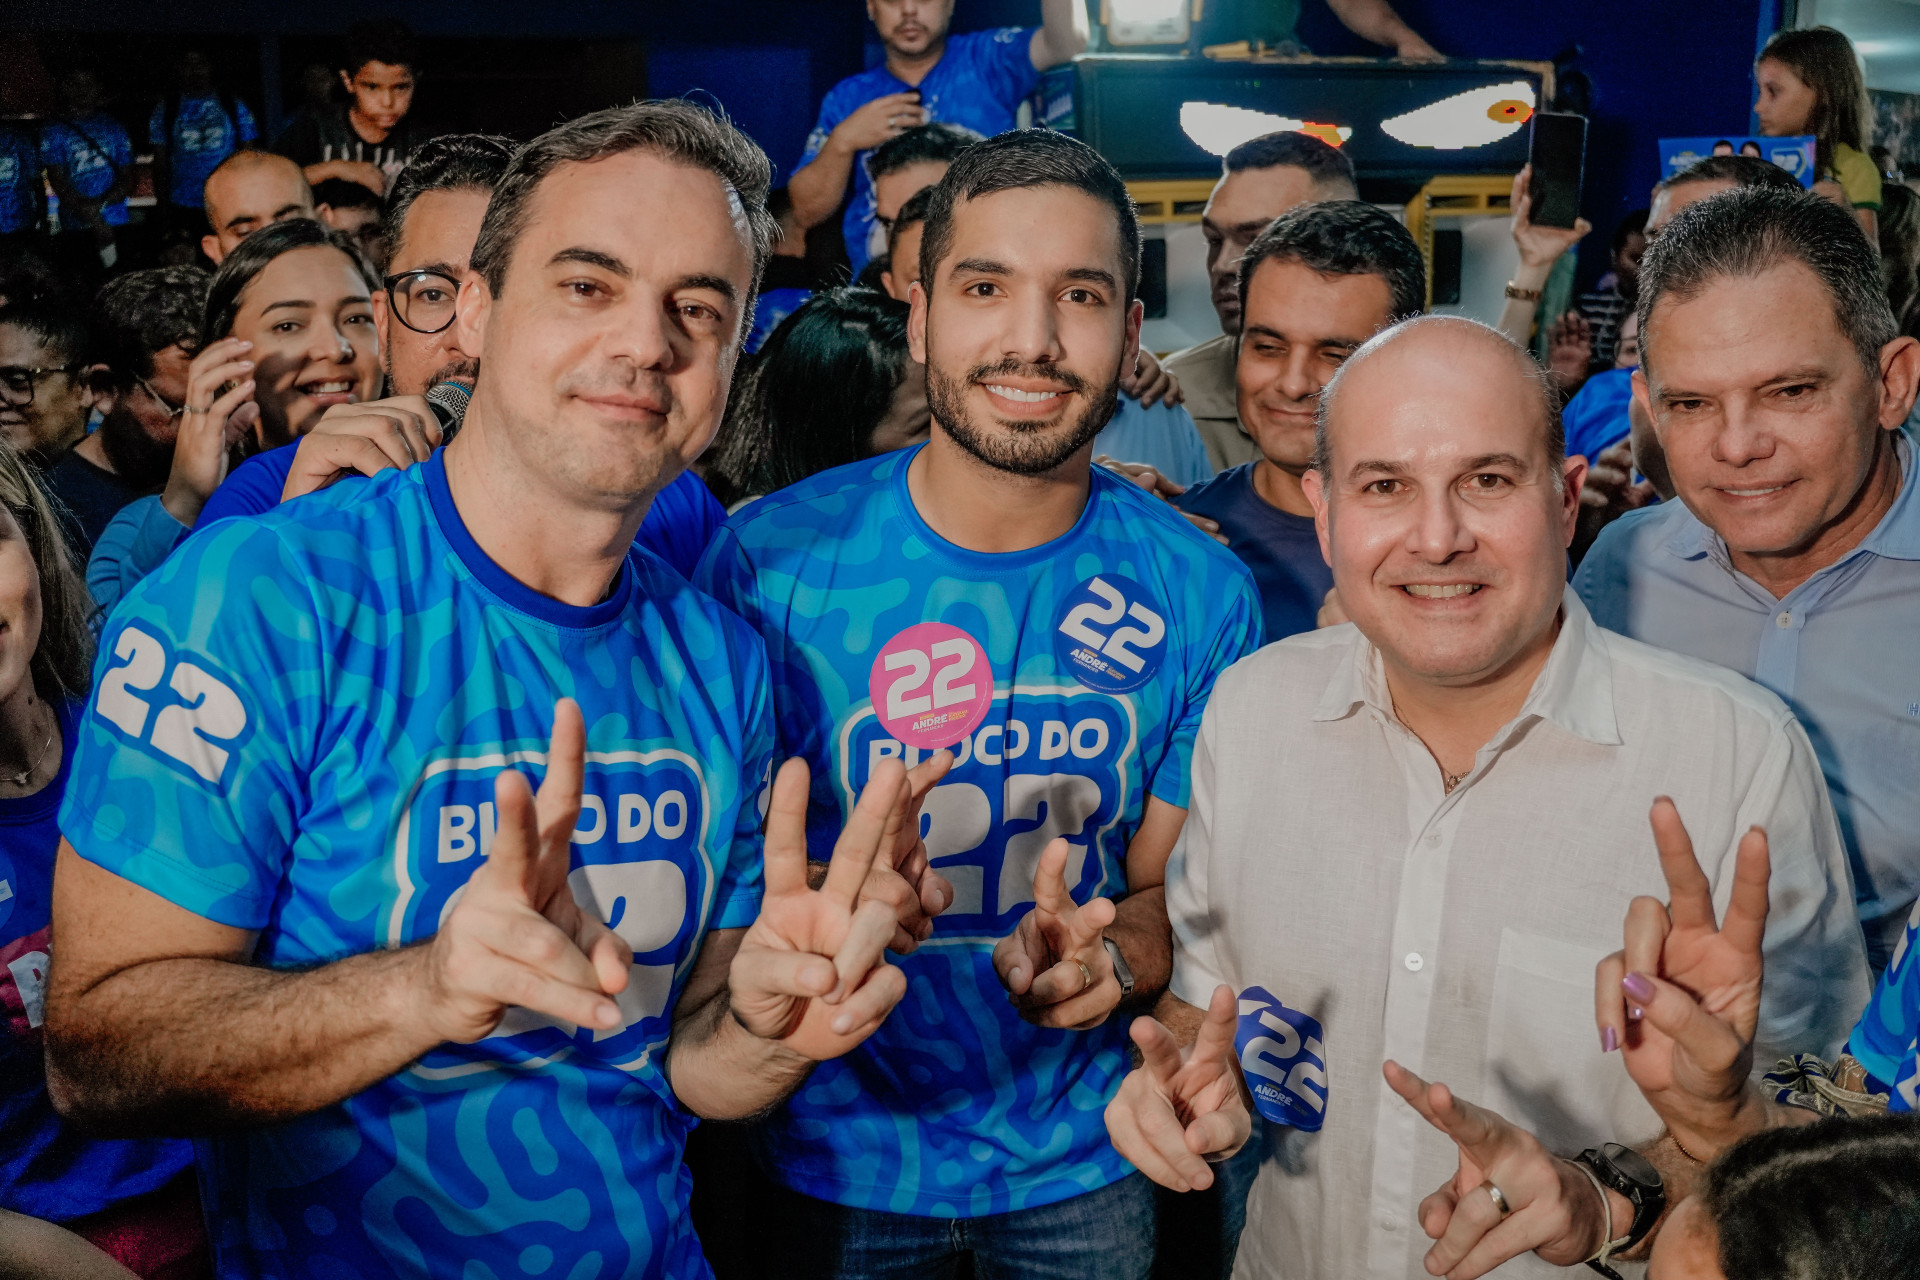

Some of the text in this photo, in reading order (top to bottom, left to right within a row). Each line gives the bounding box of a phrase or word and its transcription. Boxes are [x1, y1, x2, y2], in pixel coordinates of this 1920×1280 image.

[1058, 576, 1166, 674] 22
[884, 637, 977, 721] 22
[1069, 648, 1109, 672] ANDRÉ
[95, 625, 248, 784] 22
[1038, 717, 1110, 761] DO
[617, 789, 688, 844] DO
[1241, 1010, 1328, 1114] 22
[1254, 1084, 1293, 1106] ANDRÉ
